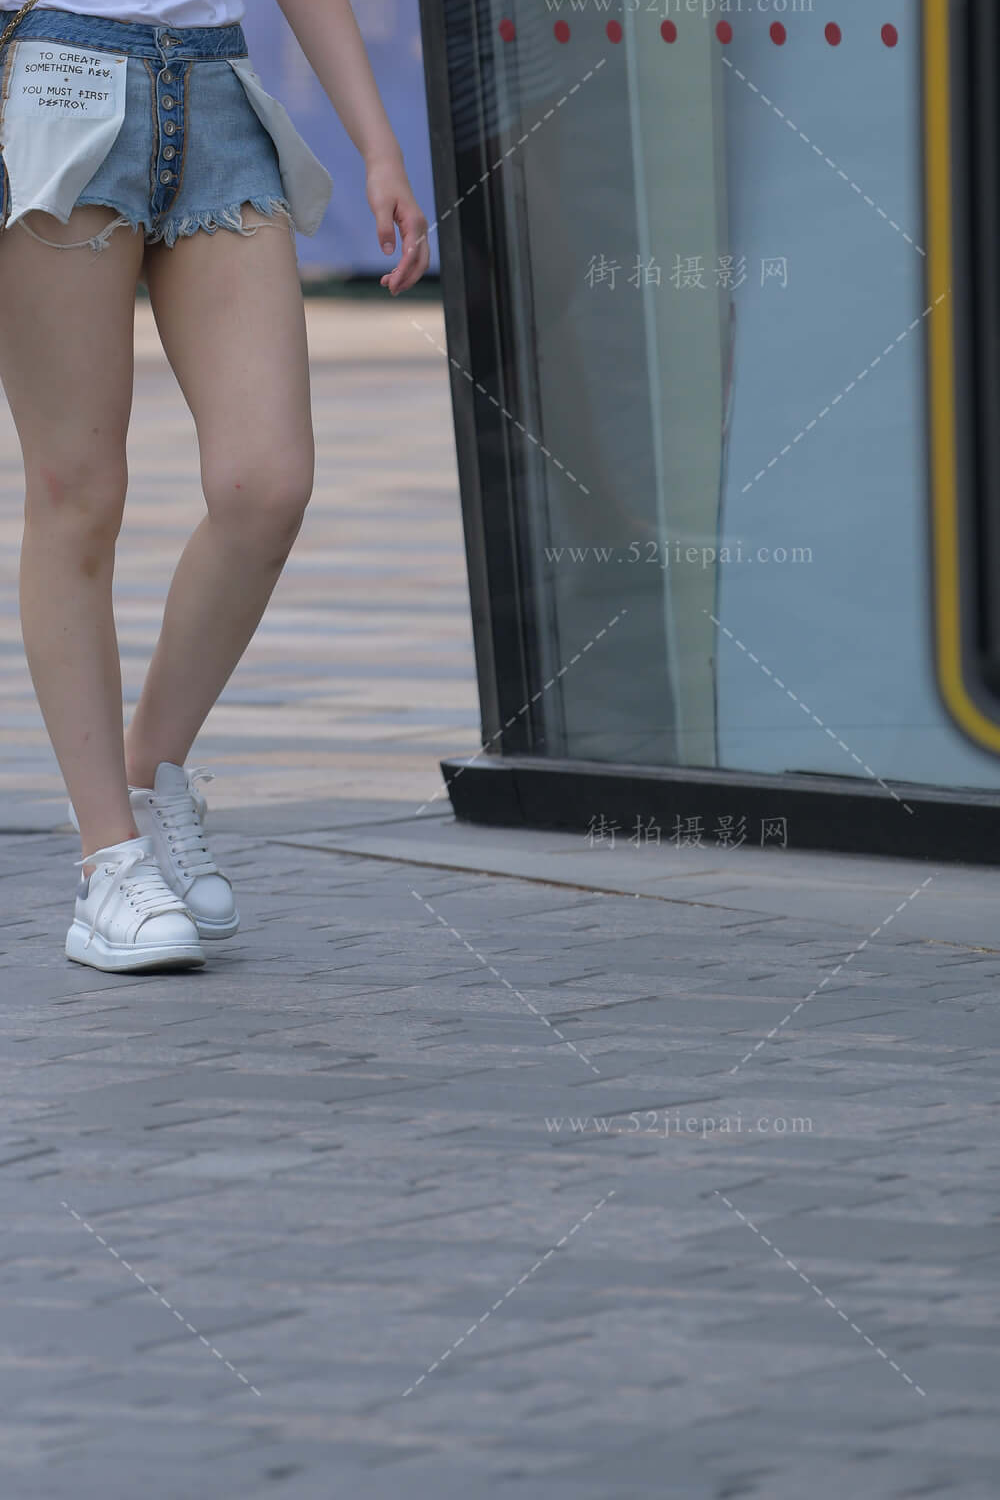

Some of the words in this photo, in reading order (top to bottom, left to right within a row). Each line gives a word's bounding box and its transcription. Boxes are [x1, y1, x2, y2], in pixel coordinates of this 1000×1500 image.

[39, 51, 54, 60] TO
[59, 52, 101, 67] CREATE
[24, 63, 83, 75] SOMETHING
[22, 86, 42, 95] YOU
[46, 86, 72, 97] MUST
